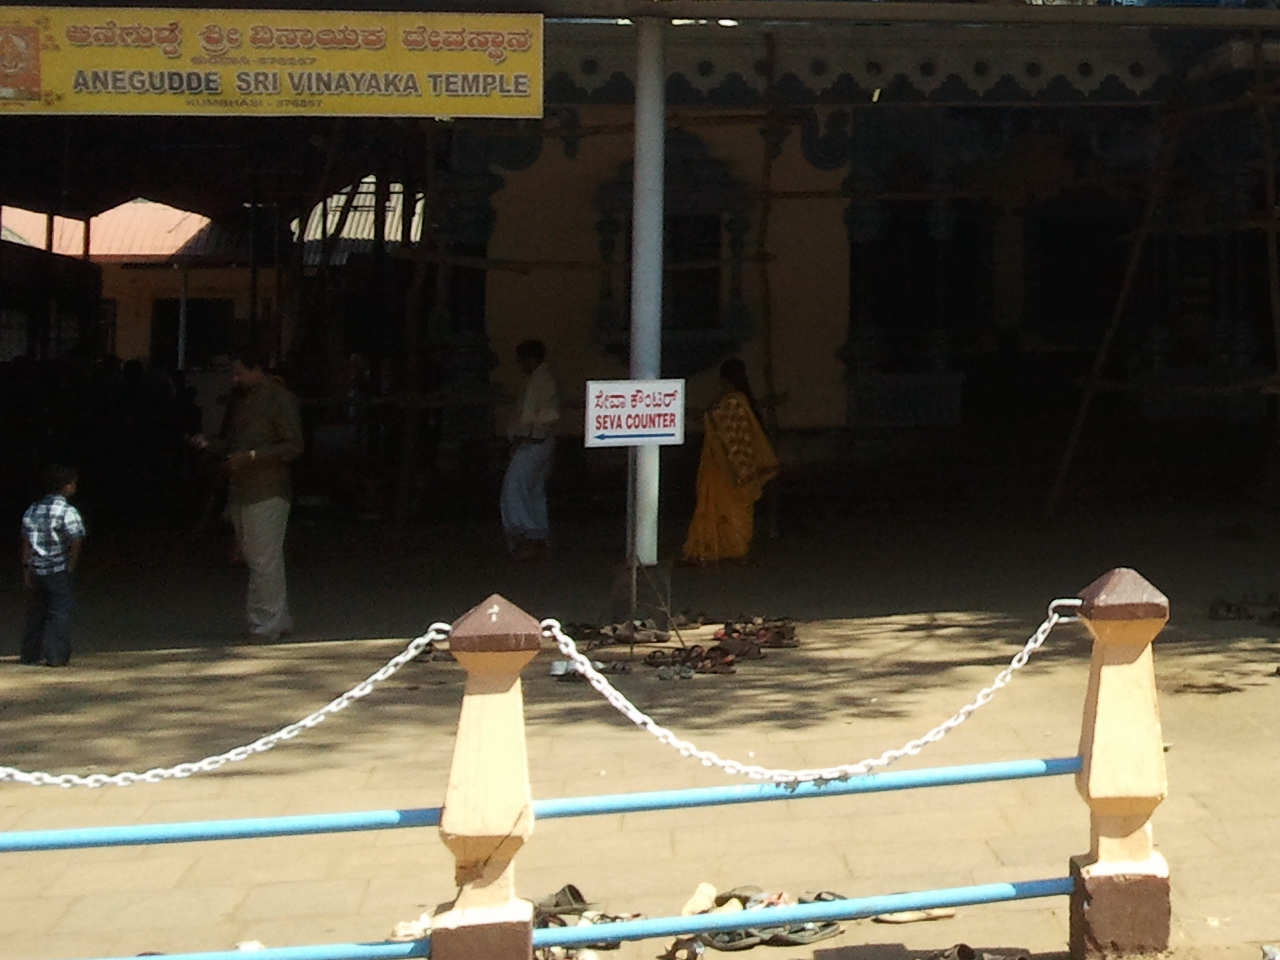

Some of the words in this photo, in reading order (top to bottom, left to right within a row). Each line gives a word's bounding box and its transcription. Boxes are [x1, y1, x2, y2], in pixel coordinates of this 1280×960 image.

[199, 23, 241, 57] ಶ್ರೀ
[249, 24, 387, 50] ವಿನಾಯಕ
[402, 25, 532, 64] ದೇವಸ್ಥಾನ
[73, 70, 222, 95] ANEGUDDE
[236, 71, 281, 95] SRI
[287, 71, 421, 96] VINAYAKA
[427, 73, 531, 97] TEMPLE
[594, 389, 627, 410] ಸೇವಾ
[630, 389, 679, 409] ಕೌಂಟರ್
[595, 414, 622, 431] SEVA
[625, 413, 676, 430] COUNTER
